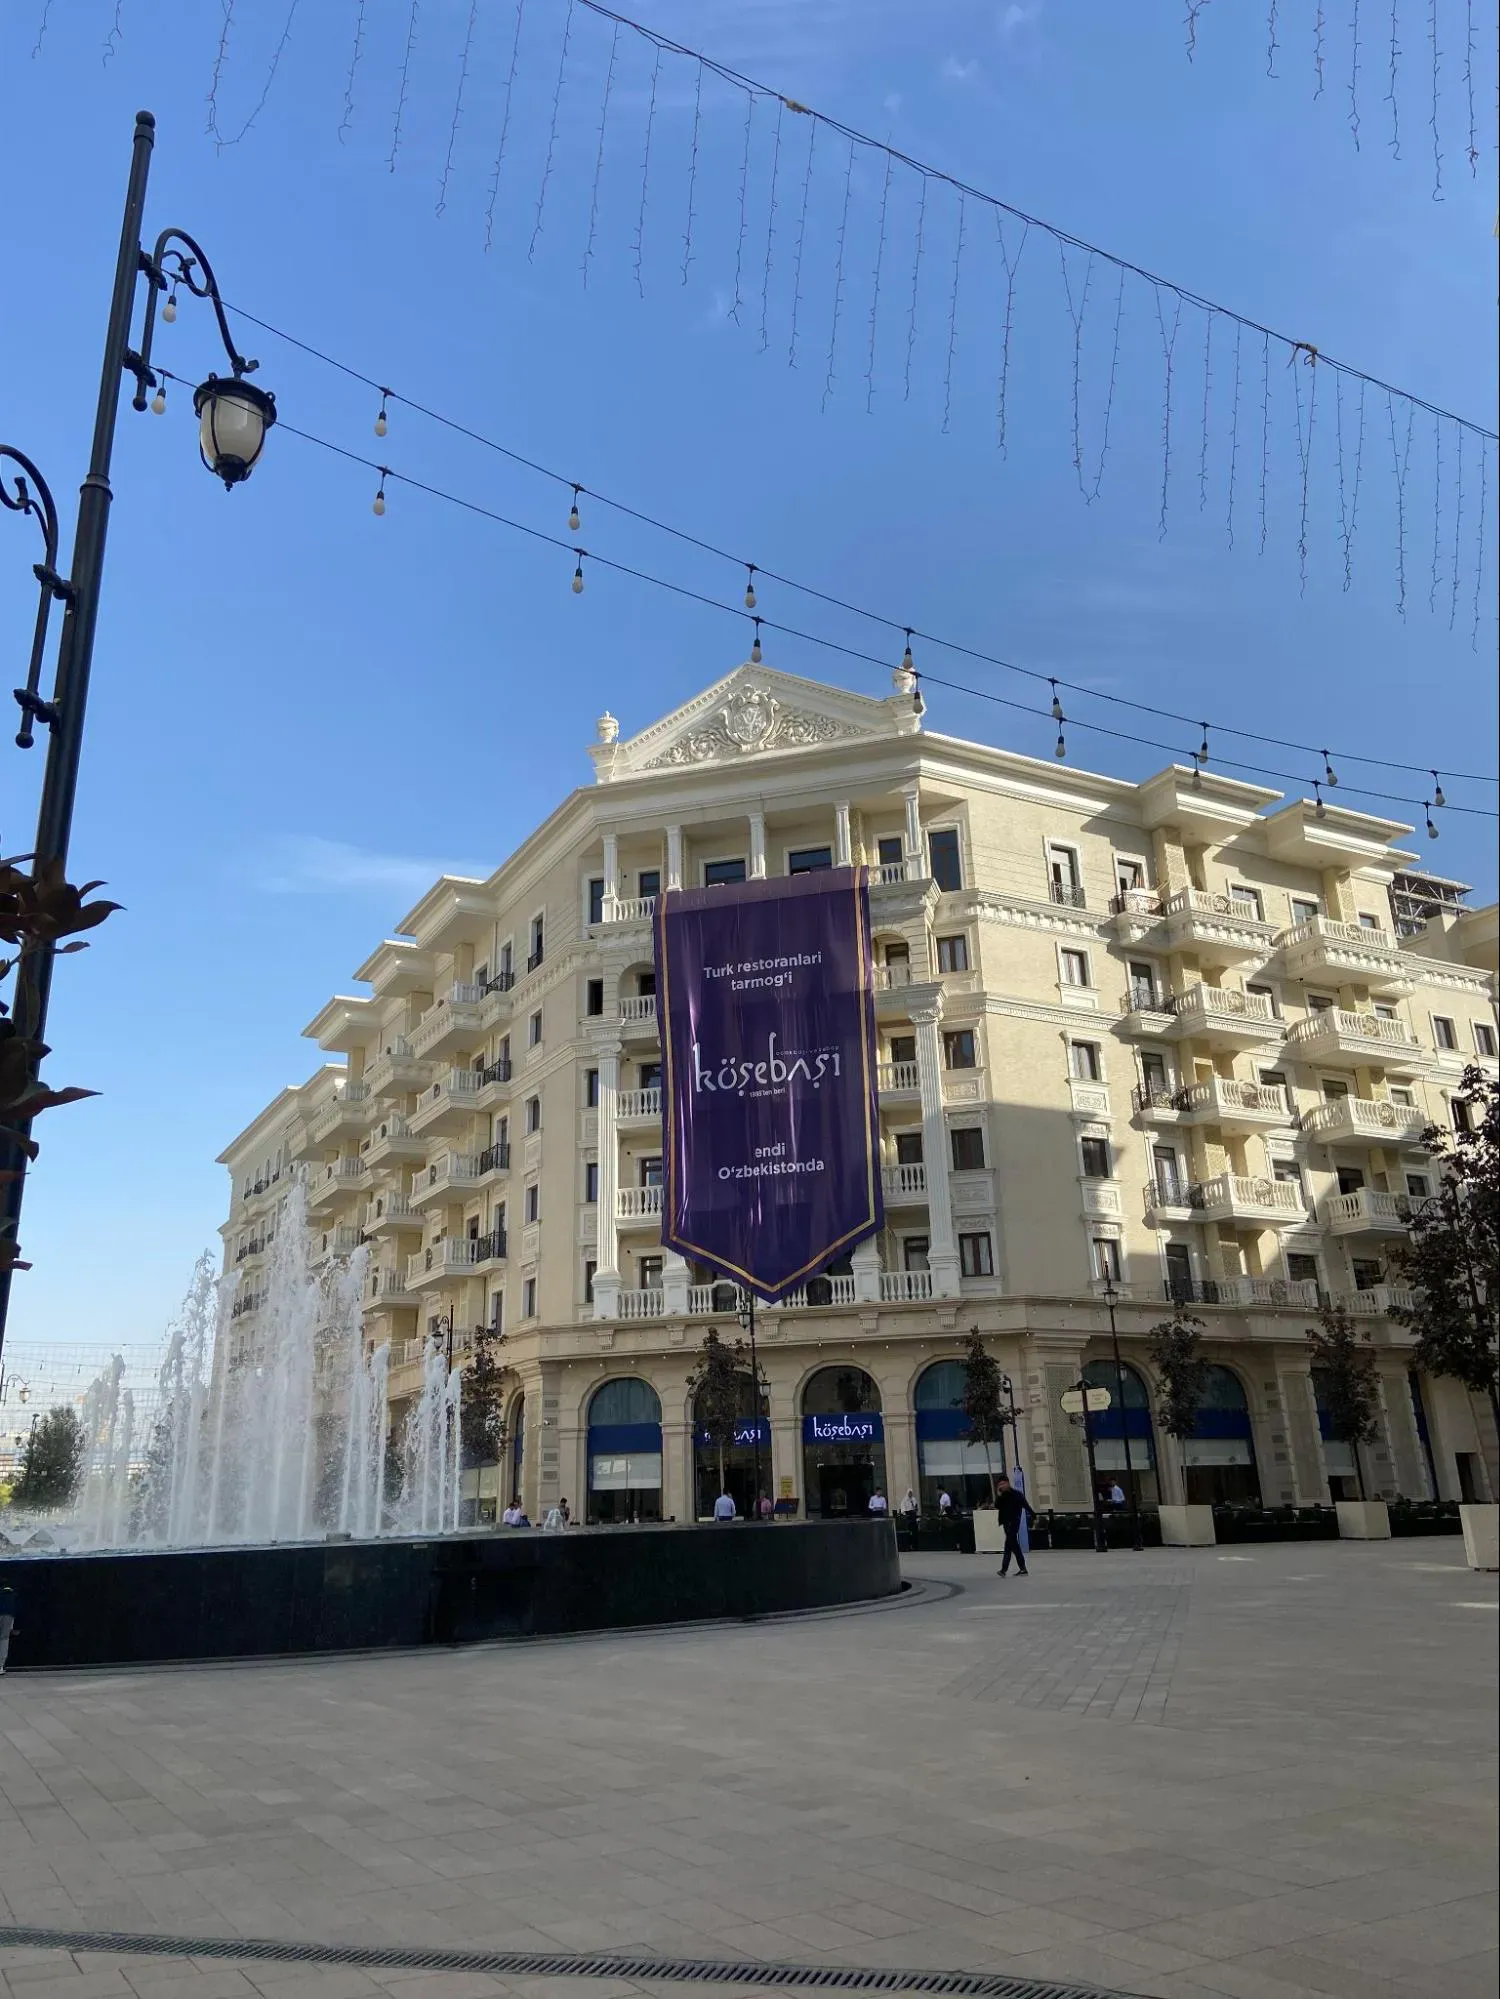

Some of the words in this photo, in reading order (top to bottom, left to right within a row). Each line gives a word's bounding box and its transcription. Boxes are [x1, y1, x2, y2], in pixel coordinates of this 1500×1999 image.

[703, 963, 734, 979] Turk
[737, 951, 822, 973] restoranlari
[755, 1142, 786, 1158] endi
